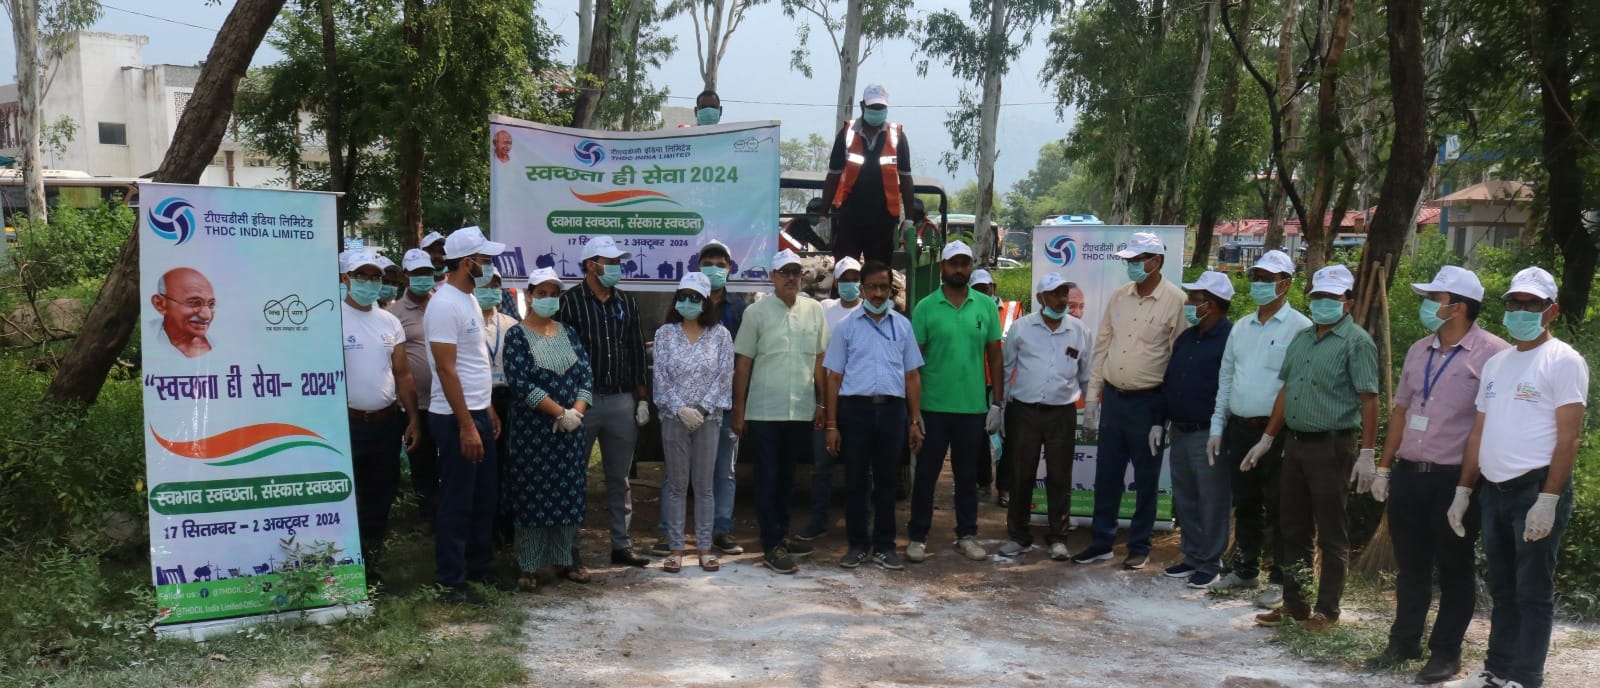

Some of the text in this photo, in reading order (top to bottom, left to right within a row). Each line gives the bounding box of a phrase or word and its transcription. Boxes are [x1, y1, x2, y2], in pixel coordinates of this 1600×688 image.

[525, 164, 738, 186] स्वच्छता ही सेवा 2024
[204, 211, 313, 228] टीएचडीसी इंडिया लिमिटेड
[552, 214, 701, 229] स्वभाव स्वच्छता, संस्कार स्वच्छता
[204, 226, 314, 240] THDC INDIA LIMITED
[632, 239, 664, 249] अक्टूबर
[226, 364, 242, 398] ही
[157, 479, 349, 506] स्वभाव स्वच्छता, संस्कार स्वच्छता
[164, 526, 178, 539] 17
[182, 519, 237, 539] सितम्बर
[253, 519, 259, 532] 2
[262, 514, 309, 537] अक्टूबर
[316, 512, 340, 526] 2024
[158, 591, 184, 600] Follow
[176, 606, 205, 617] @THDCIL
[205, 603, 220, 613] India
